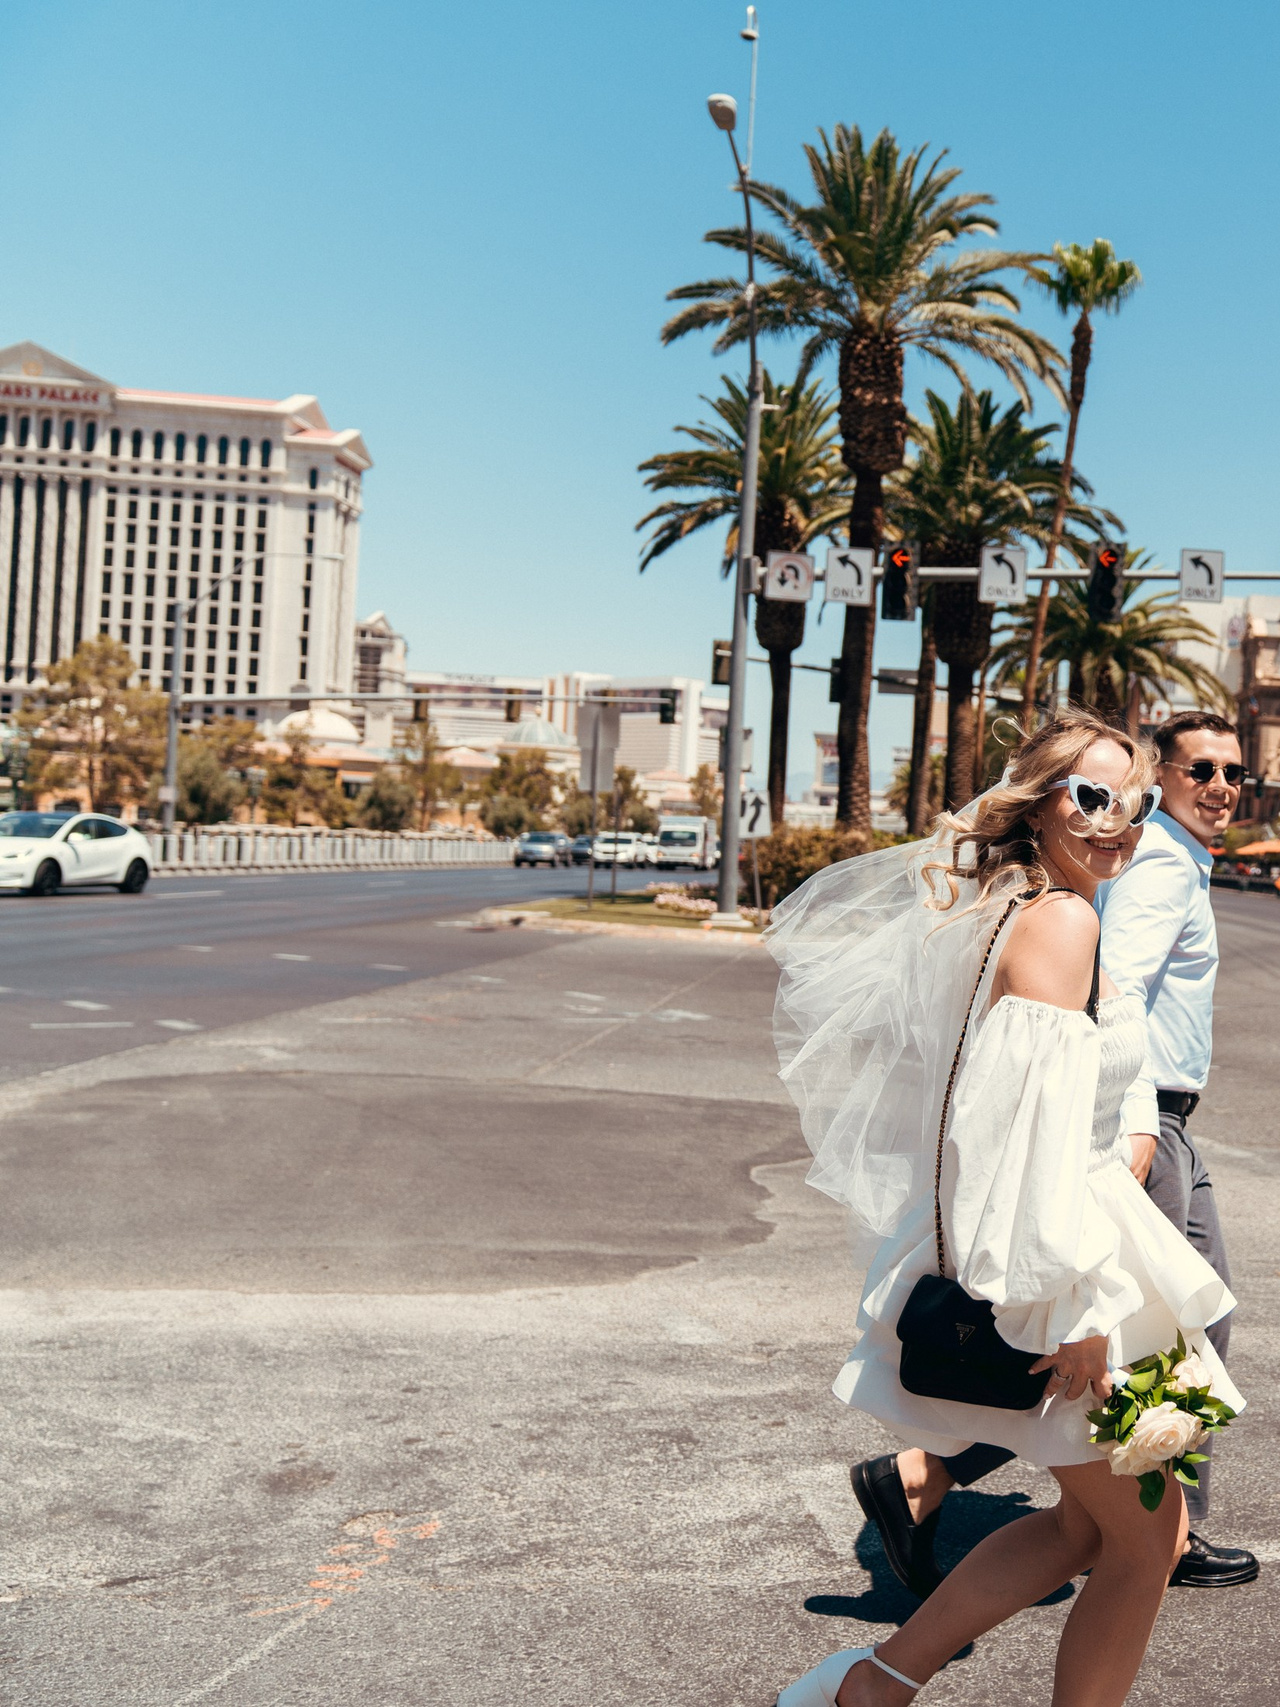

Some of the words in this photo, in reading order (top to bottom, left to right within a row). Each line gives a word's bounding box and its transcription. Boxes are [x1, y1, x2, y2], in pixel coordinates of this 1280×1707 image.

[39, 386, 99, 403] PALACE
[832, 586, 865, 599] ONLY
[985, 585, 1019, 598] ONLY
[1185, 586, 1217, 599] ONLY
